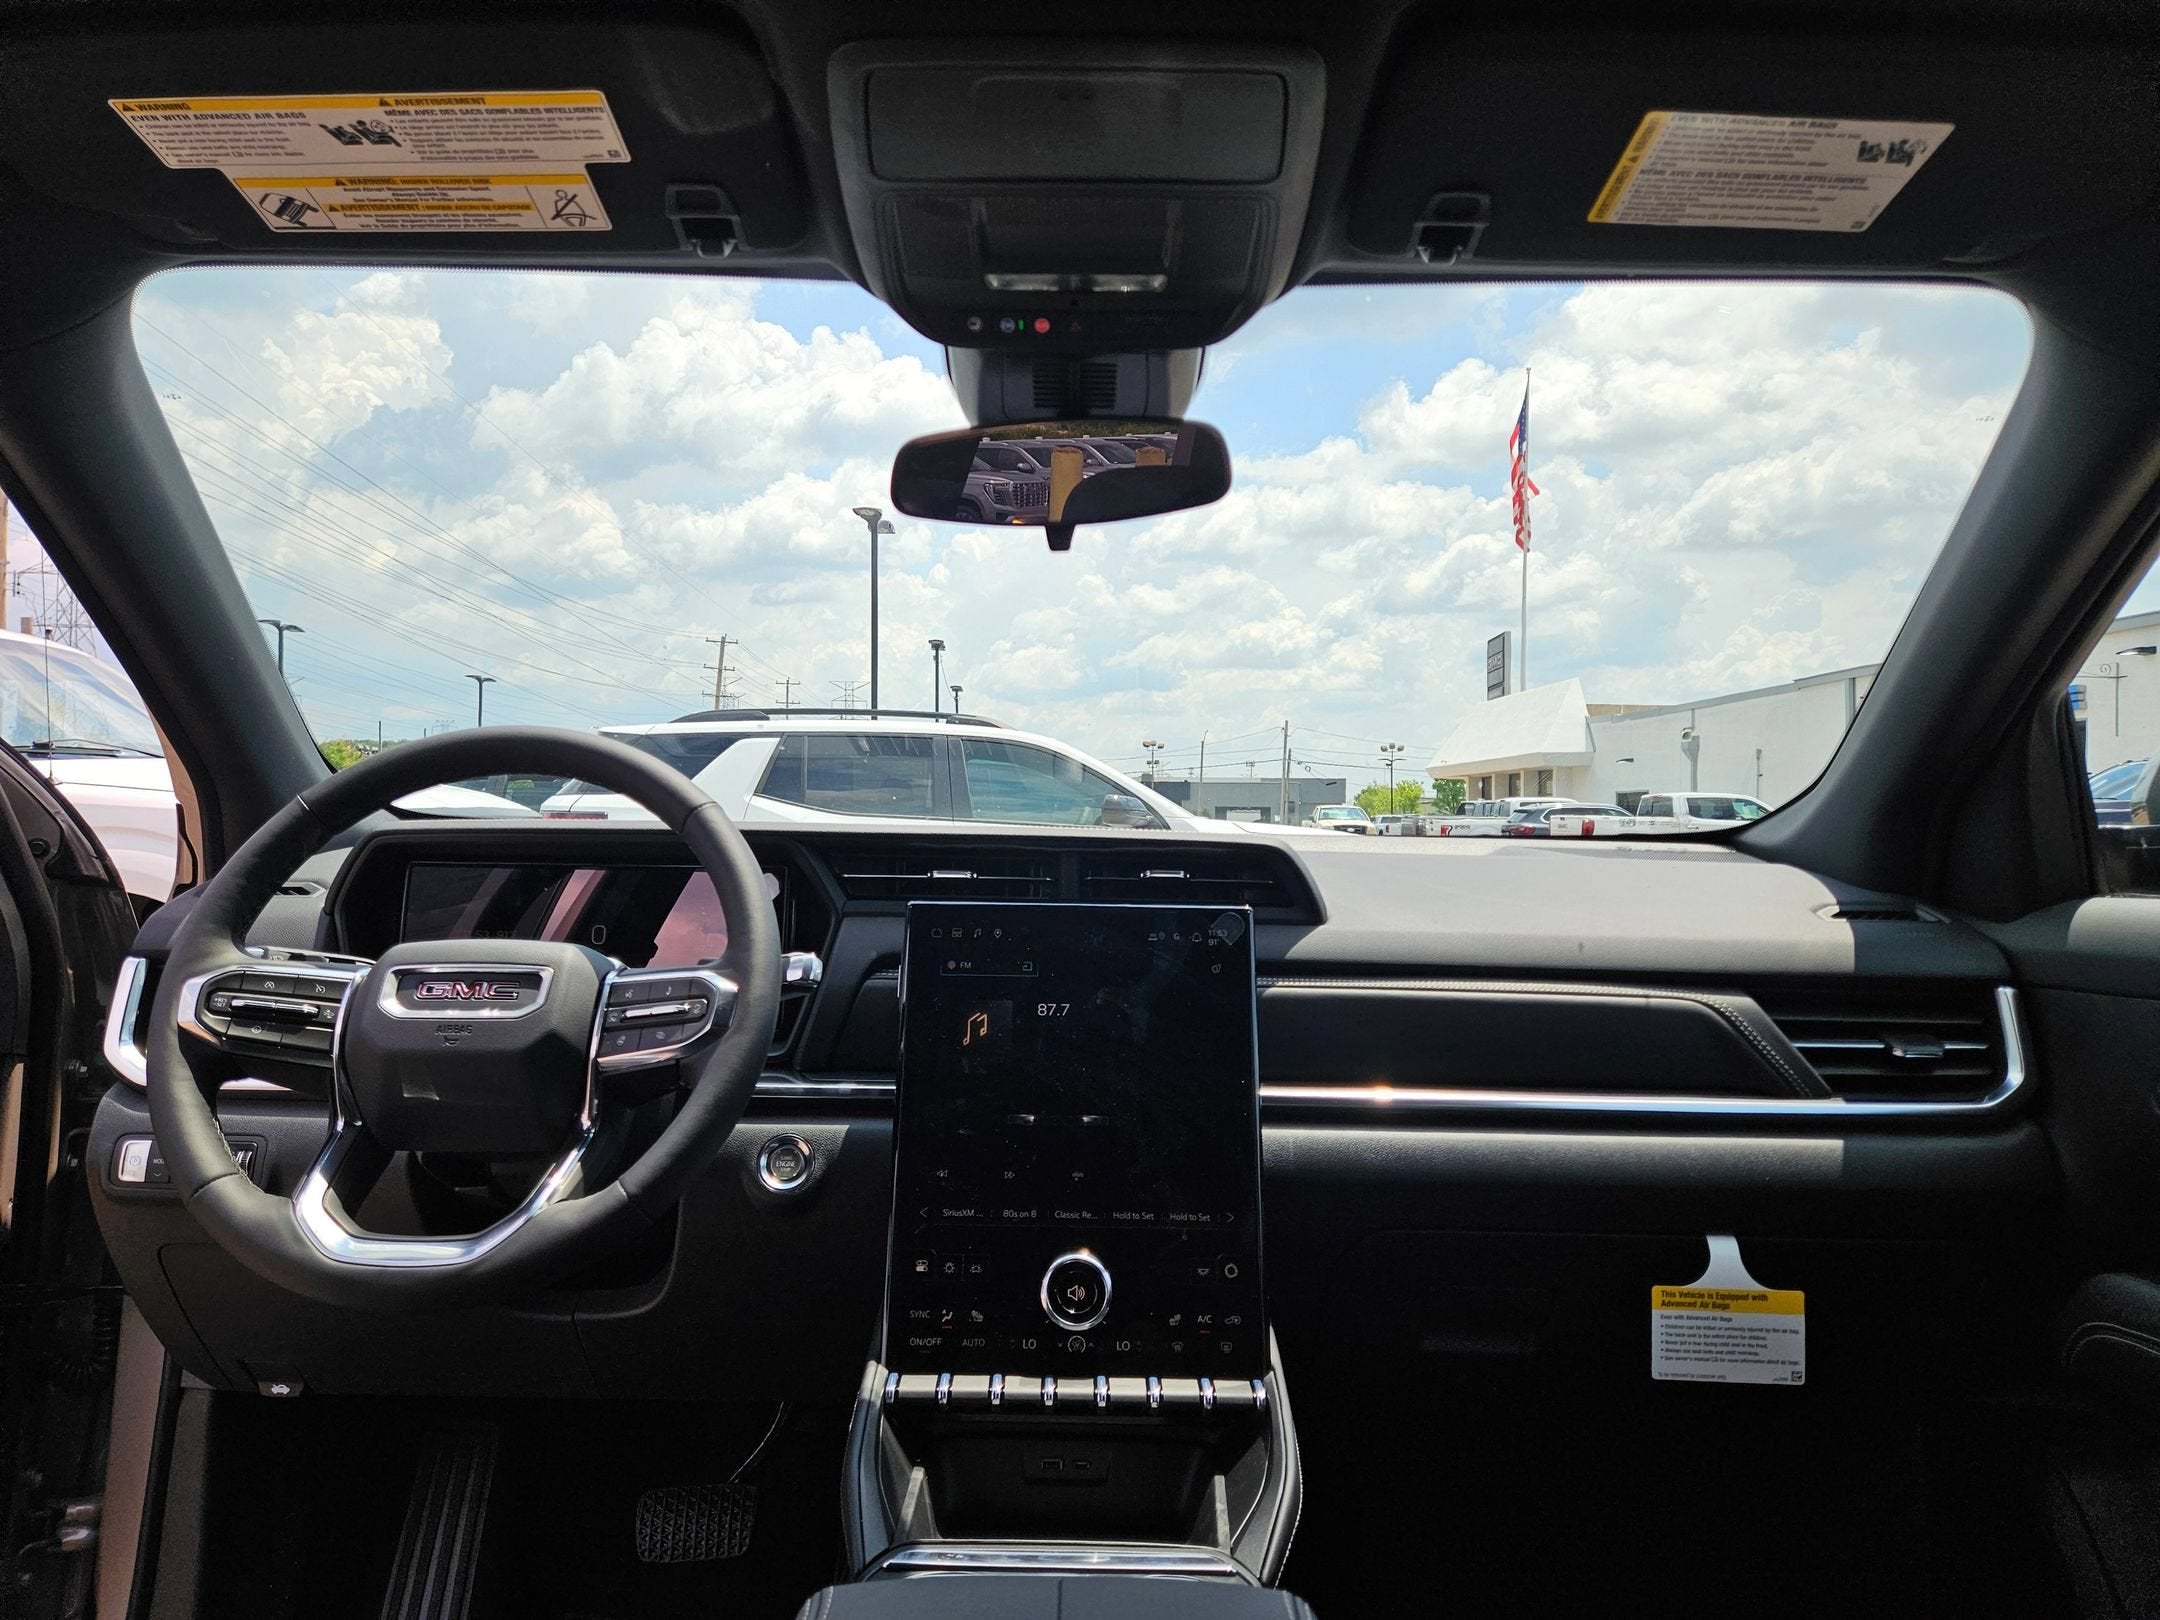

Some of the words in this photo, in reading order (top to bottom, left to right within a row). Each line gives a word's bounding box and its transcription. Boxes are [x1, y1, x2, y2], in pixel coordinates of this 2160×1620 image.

[394, 97, 486, 106] AVERTISSEMENT
[135, 102, 192, 111] WARNING
[193, 113, 252, 121] ADVANCED
[254, 112, 275, 120] AIR
[960, 961, 971, 969] FM
[415, 981, 520, 1001] GMC
[1037, 1003, 1070, 1016] 87.7
[942, 1208, 975, 1217] SiriusXM
[1002, 1209, 1018, 1218] 80s
[1031, 1210, 1038, 1218] 8
[1054, 1210, 1080, 1219] Classic
[1112, 1211, 1131, 1220] Hold
[1132, 1212, 1140, 1220] to
[1141, 1211, 1155, 1221] Set
[1169, 1212, 1188, 1221] Hold
[1188, 1213, 1197, 1222] to
[1198, 1213, 1211, 1222] Set
[1661, 1290, 1677, 1298] This
[1678, 1291, 1705, 1299] Vehicle
[1715, 1292, 1749, 1303] Equipped
[1751, 1294, 1768, 1302] with
[1660, 1300, 1697, 1308] Advanced
[1699, 1301, 1711, 1309] Air
[1711, 1302, 1730, 1310] Bags
[909, 1310, 931, 1319] SYNC
[1197, 1315, 1213, 1324] A/C
[909, 1337, 943, 1347] ON/OFF
[962, 1338, 986, 1347] AUTO
[1022, 1339, 1037, 1350] LO
[1116, 1340, 1131, 1351] LO
